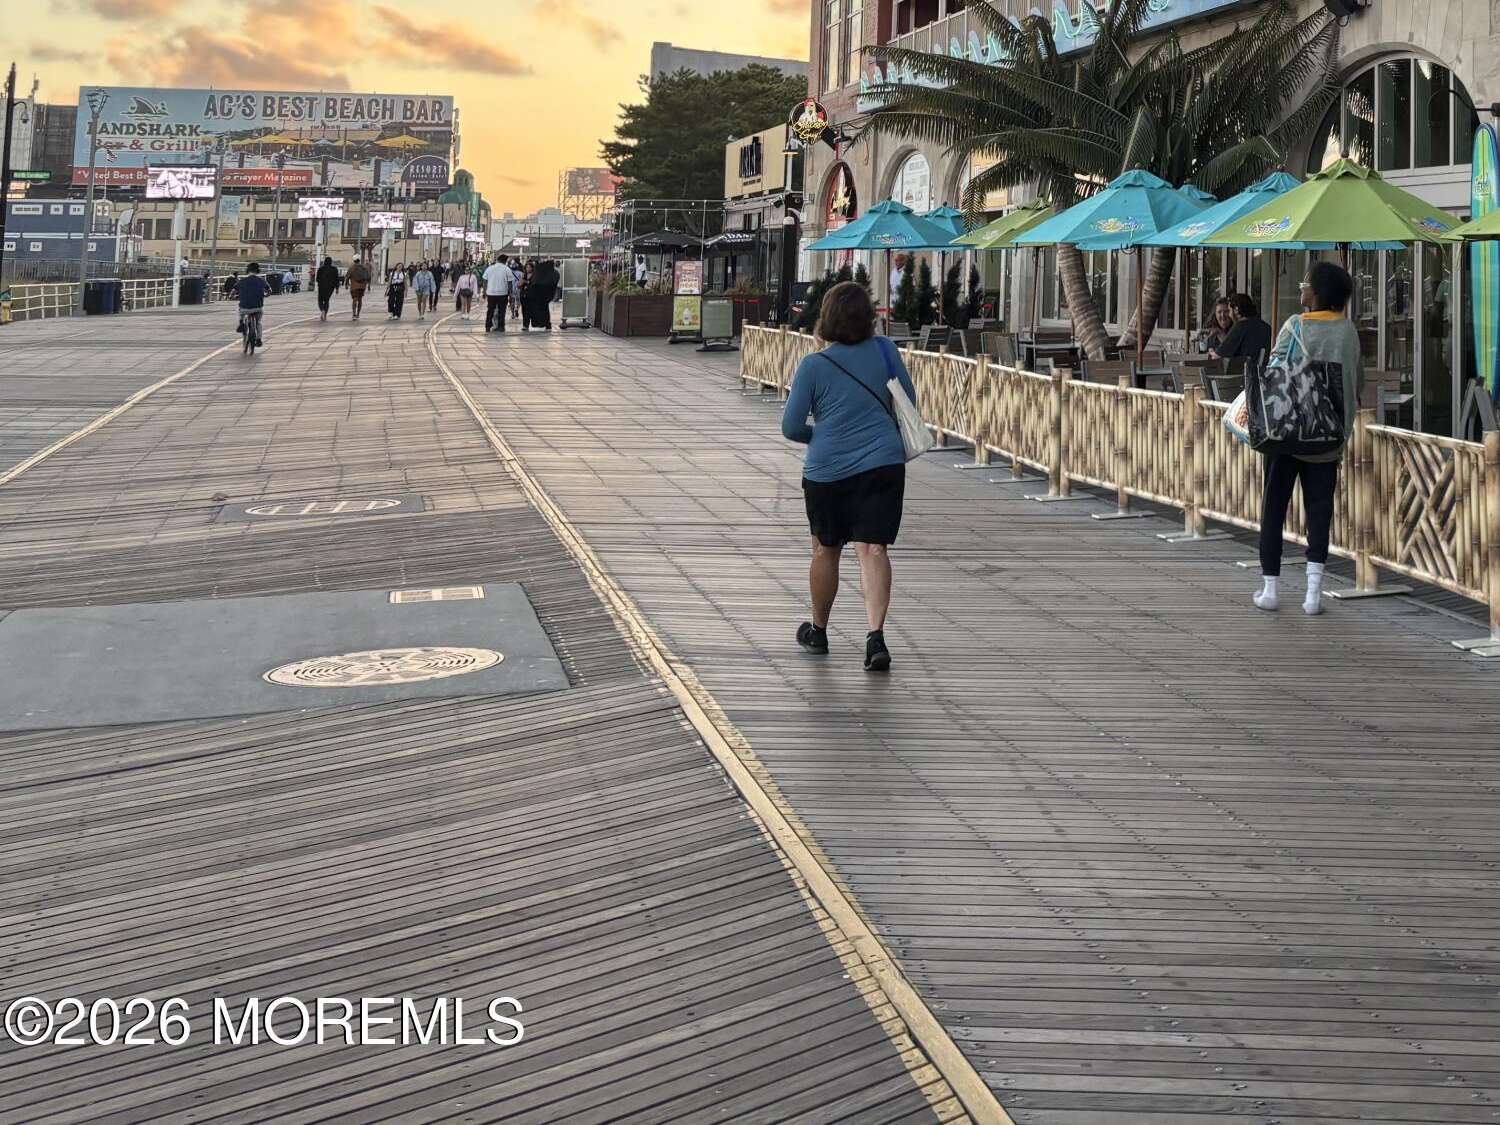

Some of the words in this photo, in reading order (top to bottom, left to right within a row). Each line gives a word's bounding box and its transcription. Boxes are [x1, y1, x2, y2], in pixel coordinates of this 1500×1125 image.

[261, 95, 319, 121] BEST
[323, 97, 395, 122] BEACH
[402, 99, 446, 123] BAR
[129, 139, 144, 151] &
[409, 164, 447, 174] RESORTS
[113, 171, 134, 180] Best
